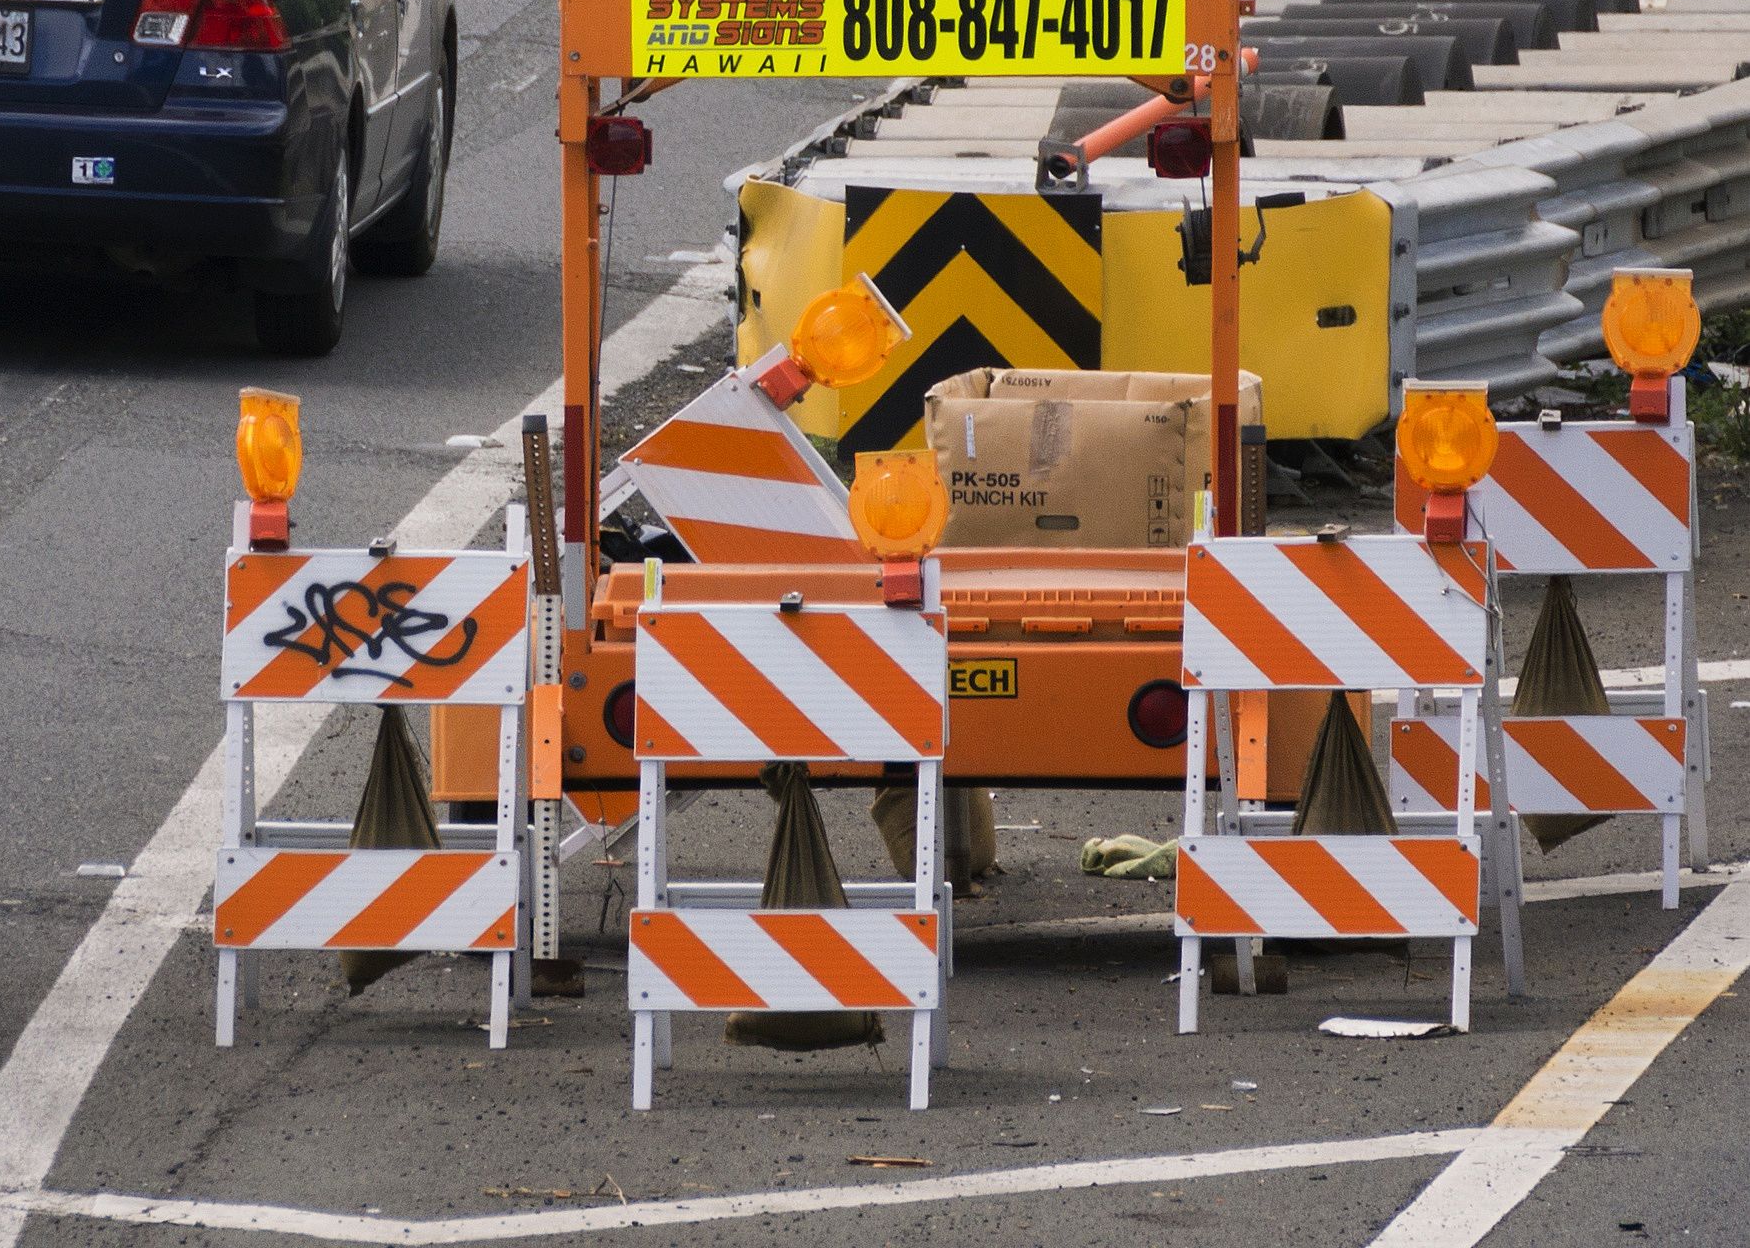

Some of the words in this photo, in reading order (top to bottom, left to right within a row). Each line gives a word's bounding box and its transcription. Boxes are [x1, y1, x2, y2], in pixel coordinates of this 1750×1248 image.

[646, 54, 828, 74] HAWAII
[1184, 43, 1217, 71] 28
[200, 66, 233, 78] LX
[79, 162, 88, 177] 1
[951, 472, 1021, 488] PK-505
[951, 490, 1014, 506] PUNCH
[1019, 490, 1049, 507] KIT
[949, 668, 1010, 692] ECH
